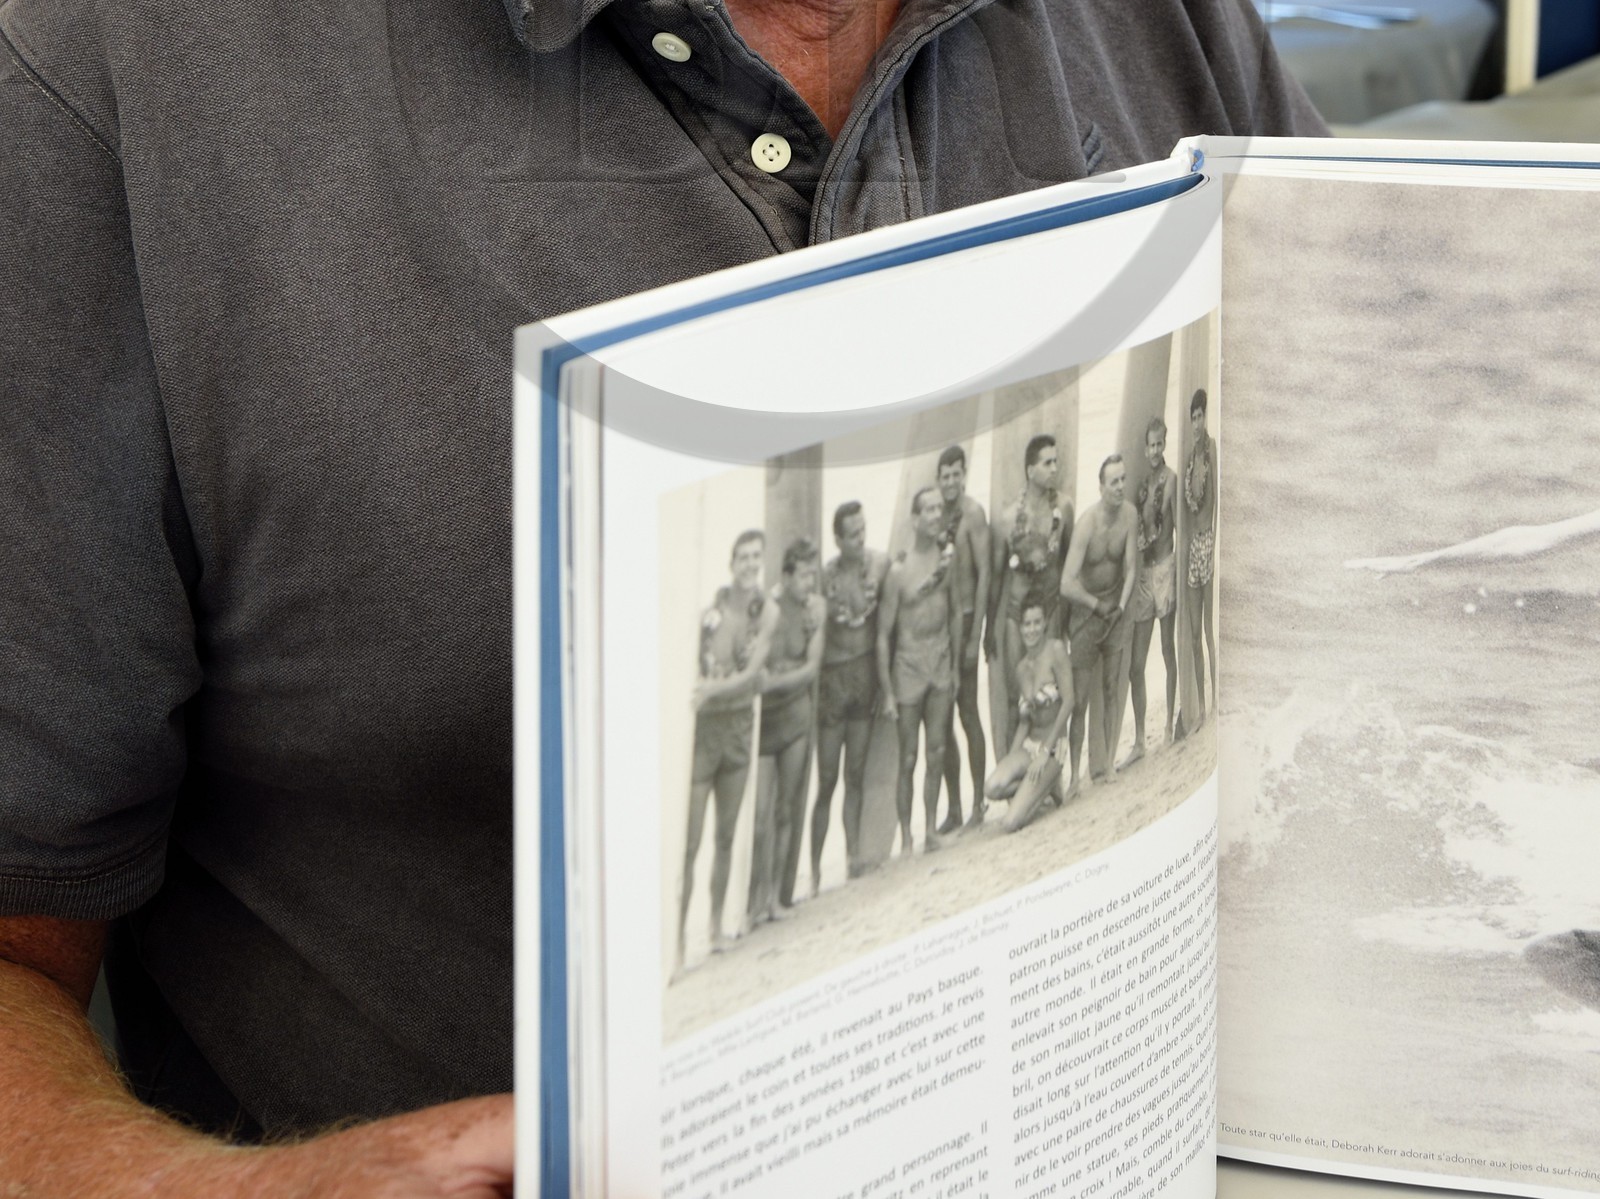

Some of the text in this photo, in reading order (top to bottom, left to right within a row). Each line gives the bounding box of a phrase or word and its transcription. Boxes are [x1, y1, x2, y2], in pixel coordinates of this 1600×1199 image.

[1009, 932, 1047, 960] ouvrait
[1050, 927, 1060, 942] la
[1063, 905, 1104, 938] portière
[1106, 899, 1119, 914] de
[1121, 893, 1132, 906] sa
[1133, 873, 1163, 899] voiture
[1164, 865, 1174, 879] de
[1176, 853, 1192, 871] luxe,
[1193, 839, 1204, 856] afin
[1009, 957, 1047, 986] patron
[1050, 938, 1083, 966] puisse
[1086, 931, 1100, 947] en
[1102, 903, 1150, 938] descendre
[1151, 888, 1171, 912] juste
[1173, 866, 1196, 894] devant
[1010, 983, 1039, 1006] ment
[1042, 974, 1062, 991] des
[1064, 959, 1094, 981] bains,
[1096, 939, 1126, 964] c'était
[1127, 916, 1161, 947] aussitôt
[1162, 906, 1178, 923] une
[1178, 890, 1196, 912] autre
[791, 965, 983, 1060] été, revenait au Pays basque.
[1010, 1007, 1040, 1029] autre
[1045, 986, 1086, 1013] monde.
[1090, 976, 1096, 990] Il
[1100, 963, 1123, 984] était
[1126, 955, 1138, 970] en
[1141, 934, 1170, 963] grande
[1172, 914, 1195, 940] forme,
[1196, 903, 1204, 916] et
[1011, 934, 1195, 1052] enlevait son peignoir de bain pour aller
[1012, 1060, 1026, 1075] de
[1030, 1049, 1050, 1066] son
[1054, 1026, 1090, 1054] maillot
[1094, 1010, 1121, 1037] jaune
[1124, 992, 1144, 1016] qu'il
[1147, 964, 1185, 1000] remontait
[701, 1010, 985, 1154] vers la fin des années 1980 et c'est avec une
[754, 1033, 986, 1154] que pu échanger avec lui sur cette
[762, 986, 985, 1099] coin et toutes ses traditions. Je revis
[1013, 1078, 1034, 1098] bril,
[1037, 1070, 1051, 1085] on
[1055, 1039, 1109, 1076] découvrait
[1111, 1032, 1123, 1046] ce
[1125, 1015, 1149, 1037] corps
[1151, 989, 1178, 1020] musclé
[1180, 984, 1188, 997] et
[1014, 1096, 1042, 1120] disait
[1047, 1083, 1071, 1104] long
[1074, 1073, 1090, 1090] sur
[1094, 1042, 1142, 1079] l'attention
[1144, 1023, 1162, 1047] qu'il
[1164, 1021, 1170, 1035] y
[1171, 997, 1197, 1029] portait.
[1014, 1125, 1040, 1144] alors
[1043, 1099, 1081, 1132] jusqu'à
[1084, 1085, 1108, 1108] l'eau
[1110, 1061, 1144, 1092] couvert
[1146, 1036, 1179, 1068] d'ambre
[1180, 1014, 1202, 1041] solaire,
[803, 1059, 987, 1154] mais sa mémoire était demeu-
[861, 1120, 988, 1198] grand personnage. Il
[1014, 1146, 1040, 1166] avec
[1042, 1133, 1063, 1152] une
[1066, 1118, 1093, 1144] paire
[1095, 1108, 1108, 1124] de
[1110, 1074, 1158, 1115] chaussures
[1160, 1064, 1171, 1079] de
[1172, 1043, 1195, 1070] tennis.
[1015, 1172, 1031, 1189] nir
[1032, 1163, 1047, 1181] de
[1049, 1157, 1059, 1172] le
[1061, 1146, 1081, 1164] voir
[1084, 1120, 1123, 1156] prendre
[1125, 1109, 1141, 1127] des
[1142, 1087, 1170, 1115] vagues
[1171, 1058, 1200, 1096] jusqu'au
[1062, 1169, 1082, 1188] une
[1086, 1148, 1120, 1176] statue,
[1124, 1133, 1139, 1151] ses
[1142, 1114, 1164, 1141] pieds
[1167, 1066, 1209, 1120] pratiquement
[1079, 1178, 1105, 1199] croix
[1115, 1156, 1140, 1179] Mais,
[1142, 1128, 1173, 1159] comble
[1174, 1118, 1185, 1133] du
[1147, 1146, 1173, 1178] quand
[1175, 1141, 1180, 1154] il
[1182, 1119, 1203, 1147] surfait,
[1220, 1122, 1247, 1135] Toute
[1249, 1129, 1267, 1140] star
[1269, 1132, 1302, 1143] qu'elle
[1304, 1136, 1329, 1149] était,
[1331, 1139, 1375, 1154] Deborah
[1377, 1145, 1398, 1157] Kerr
[1400, 1149, 1435, 1161] adorait
[1437, 1152, 1487, 1167] s'adonner
[1489, 1160, 1508, 1169] aux
[1509, 1161, 1534, 1172] joies
[1535, 1163, 1549, 1173] du
[909, 1145, 988, 1194] en reprenant
[947, 1176, 973, 1198] était
[979, 1169, 989, 1182] le
[1157, 1135, 1205, 1191] de son maillot
